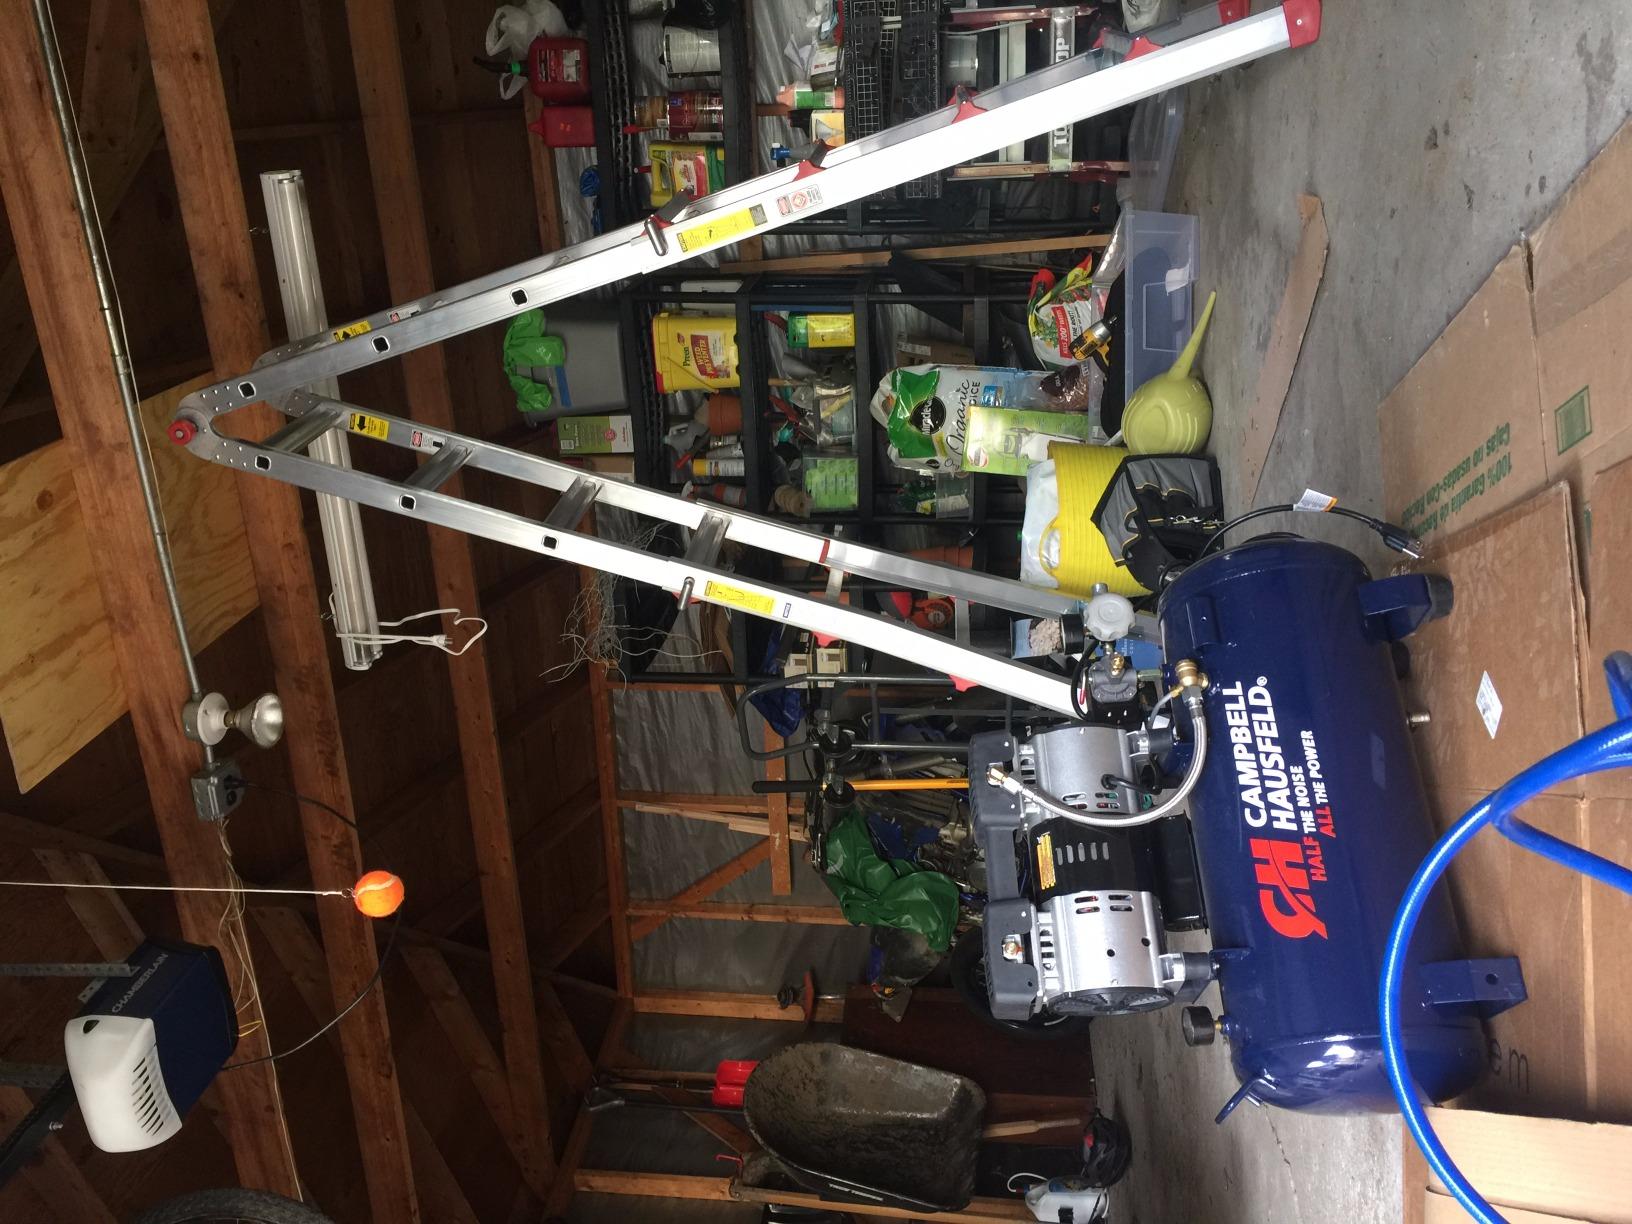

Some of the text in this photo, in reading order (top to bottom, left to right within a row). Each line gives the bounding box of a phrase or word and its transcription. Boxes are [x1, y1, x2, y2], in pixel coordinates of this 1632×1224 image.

[946, 378, 970, 456] Organic
[1222, 680, 1268, 828] CAMPBELL
[1300, 730, 1336, 838] ALL THE POWER
[1290, 765, 1328, 882] HALF THE NOISE
[111, 953, 168, 1012] CHAMBERLAIN
